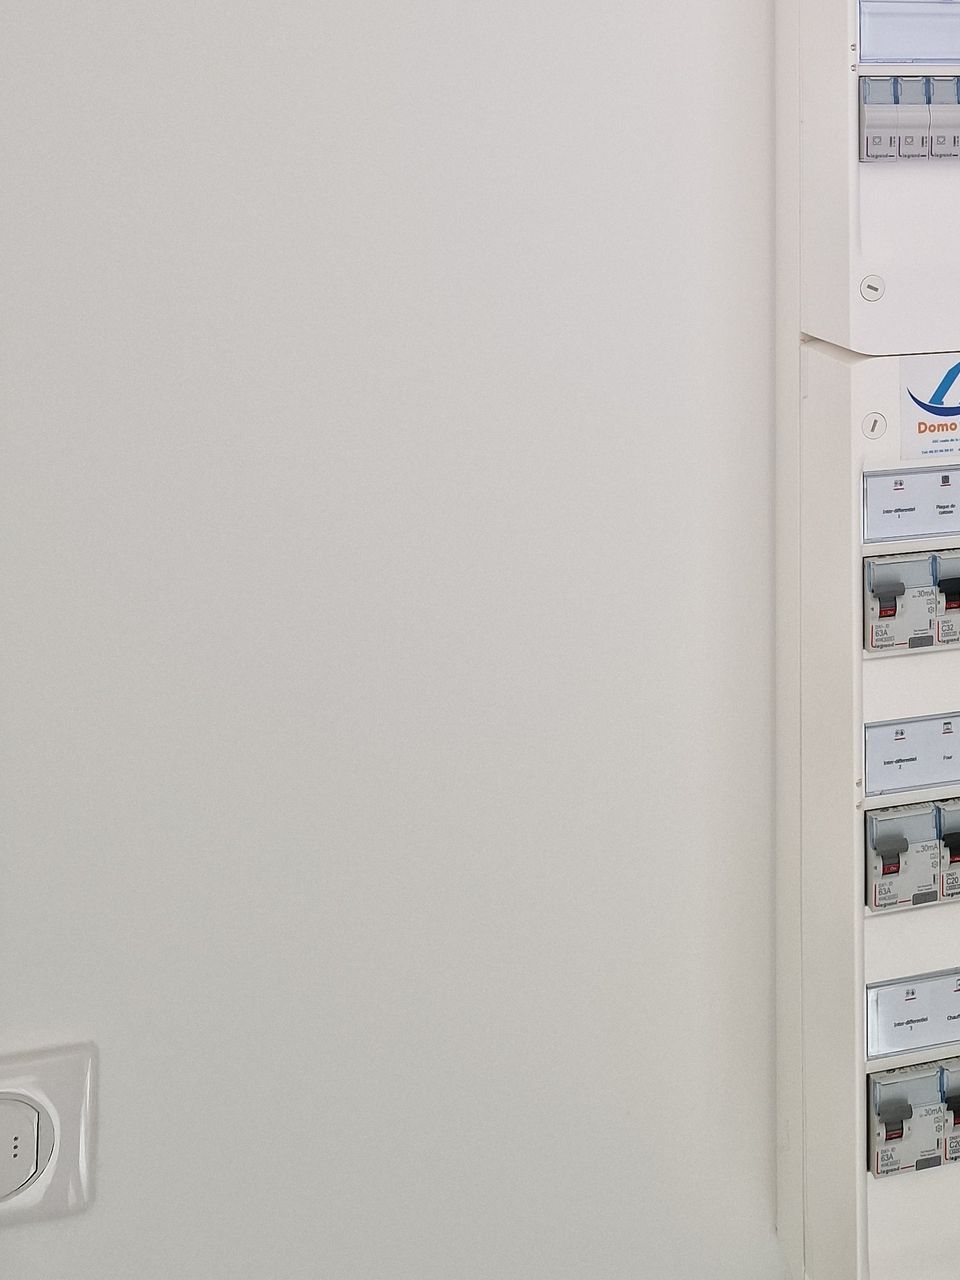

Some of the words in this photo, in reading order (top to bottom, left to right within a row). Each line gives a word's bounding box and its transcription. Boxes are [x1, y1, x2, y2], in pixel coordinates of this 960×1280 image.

[917, 421, 957, 434] Domo
[918, 590, 935, 598] 30mA
[941, 624, 954, 633] C32
[875, 629, 888, 637] 63A
[920, 843, 938, 852] 30mA
[946, 877, 959, 885] C20
[878, 887, 891, 895] 63A
[924, 1106, 943, 1116] 30mA
